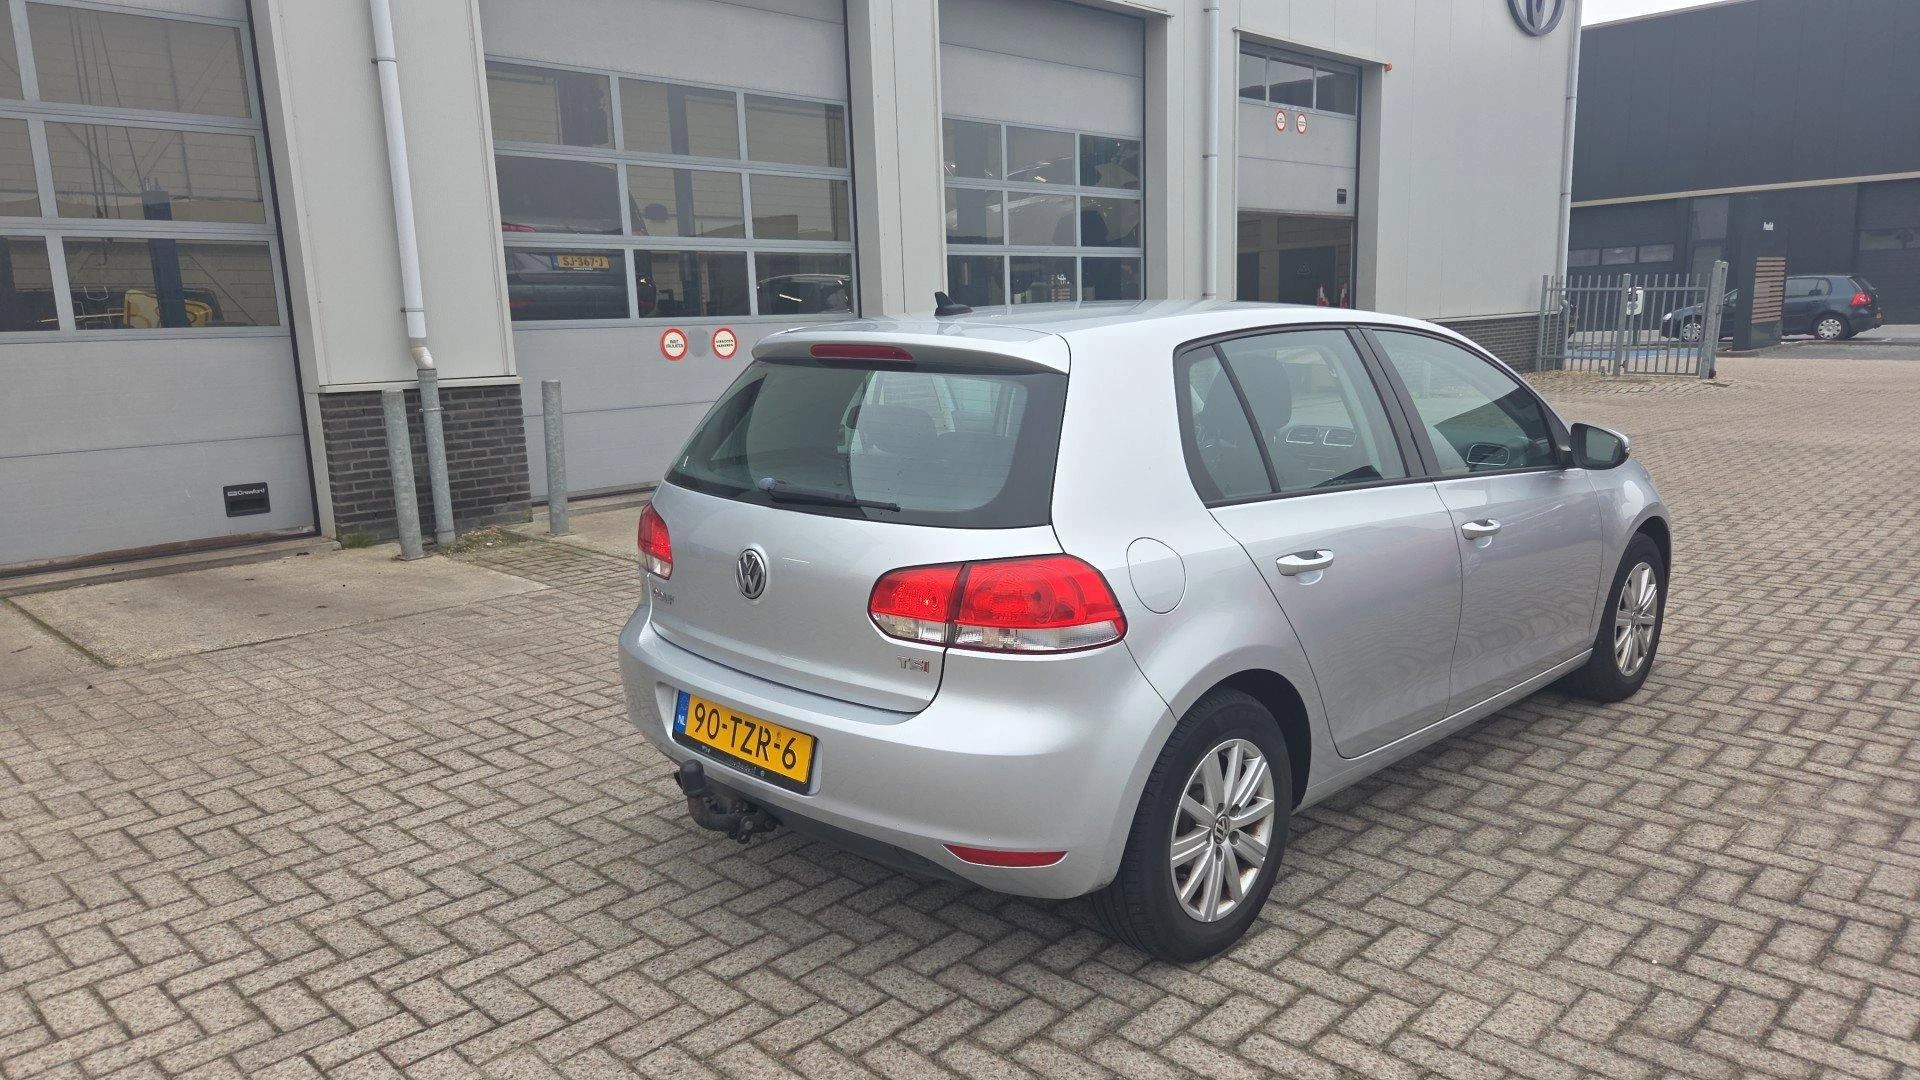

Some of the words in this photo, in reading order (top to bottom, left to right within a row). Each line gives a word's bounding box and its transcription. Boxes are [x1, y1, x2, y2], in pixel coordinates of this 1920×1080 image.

[562, 256, 604, 267] SJ-367-J
[897, 655, 930, 673] TSI
[694, 702, 797, 770] 90-TZR-6
